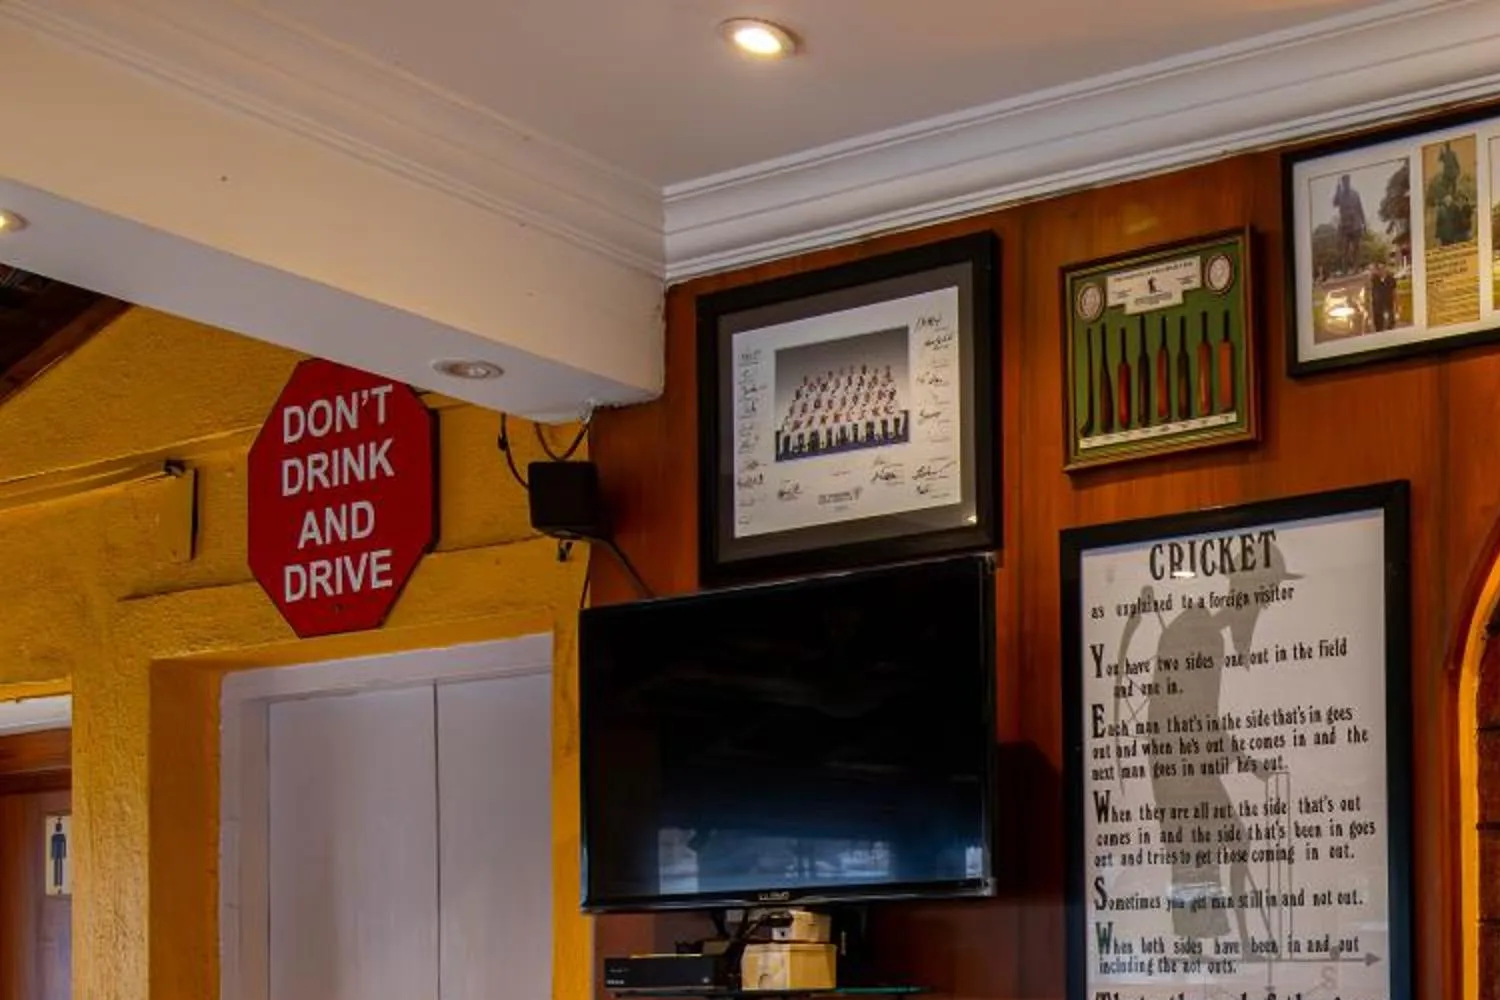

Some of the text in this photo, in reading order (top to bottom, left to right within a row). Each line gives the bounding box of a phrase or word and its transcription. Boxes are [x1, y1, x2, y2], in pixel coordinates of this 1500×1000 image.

[284, 384, 394, 444] DON'T
[282, 438, 395, 497] DRINK
[297, 500, 376, 549] AND
[1149, 529, 1277, 581] CRICKET
[284, 549, 393, 603] DRIVE
[1091, 606, 1105, 619] as
[1116, 593, 1174, 618] explained
[1181, 593, 1193, 609] to
[1209, 588, 1249, 610] foreign
[1254, 585, 1295, 603] visitor
[1089, 643, 1119, 679] You
[1125, 658, 1151, 675] have
[1157, 656, 1179, 672] two
[1185, 651, 1214, 671] sides
[1225, 655, 1243, 668] one
[1250, 648, 1268, 665] out
[1275, 643, 1287, 662] in
[1293, 641, 1313, 660] the
[1114, 680, 1133, 699] and
[1142, 682, 1160, 696] one
[1091, 703, 1129, 738] Each
[1135, 721, 1159, 735] man
[1207, 714, 1219, 731] in
[1222, 712, 1241, 731] the
[1246, 709, 1270, 728] side
[1309, 705, 1321, 724] in
[1093, 744, 1111, 760] out
[1116, 739, 1137, 758] and
[1142, 739, 1173, 756] when
[1206, 737, 1224, 754] out
[1231, 734, 1245, 752] he
[1249, 734, 1286, 751] comes
[1293, 728, 1306, 747] in
[1313, 725, 1336, 745] and
[1347, 725, 1368, 744] the
[1092, 766, 1114, 781] next
[1121, 765, 1146, 779] man
[1153, 760, 1177, 780] goes
[1182, 757, 1195, 777] in
[1200, 756, 1229, 775] until
[1093, 789, 1132, 824] When
[1140, 803, 1166, 823] they
[1170, 806, 1189, 820] are
[1193, 801, 1209, 819] all
[1214, 804, 1232, 819] out
[1240, 799, 1258, 817] the
[1263, 796, 1287, 816] side
[1340, 794, 1360, 812] out
[1097, 831, 1131, 846] comes
[1138, 826, 1151, 845] in
[1160, 826, 1183, 844] and
[1192, 825, 1211, 843] the
[1218, 823, 1242, 843] side
[1294, 821, 1322, 838] been
[1329, 818, 1343, 837] in
[1349, 821, 1376, 840] goes
[1095, 852, 1113, 868] out
[1121, 848, 1143, 867] and
[1148, 847, 1178, 865] tries
[1180, 849, 1191, 865] to
[1195, 850, 1211, 868] get
[1217, 846, 1248, 865] those
[1251, 843, 1295, 865] coming
[1305, 842, 1319, 861] in
[1094, 875, 1161, 911] Sometimes
[1239, 889, 1263, 909] still
[1265, 888, 1277, 907] in
[1282, 887, 1305, 907] and
[1313, 889, 1332, 907] not
[1096, 921, 1359, 955] When both sides have been in and out
[1100, 956, 1153, 976] including
[1158, 955, 1177, 973] the
[1183, 957, 1202, 974] not
